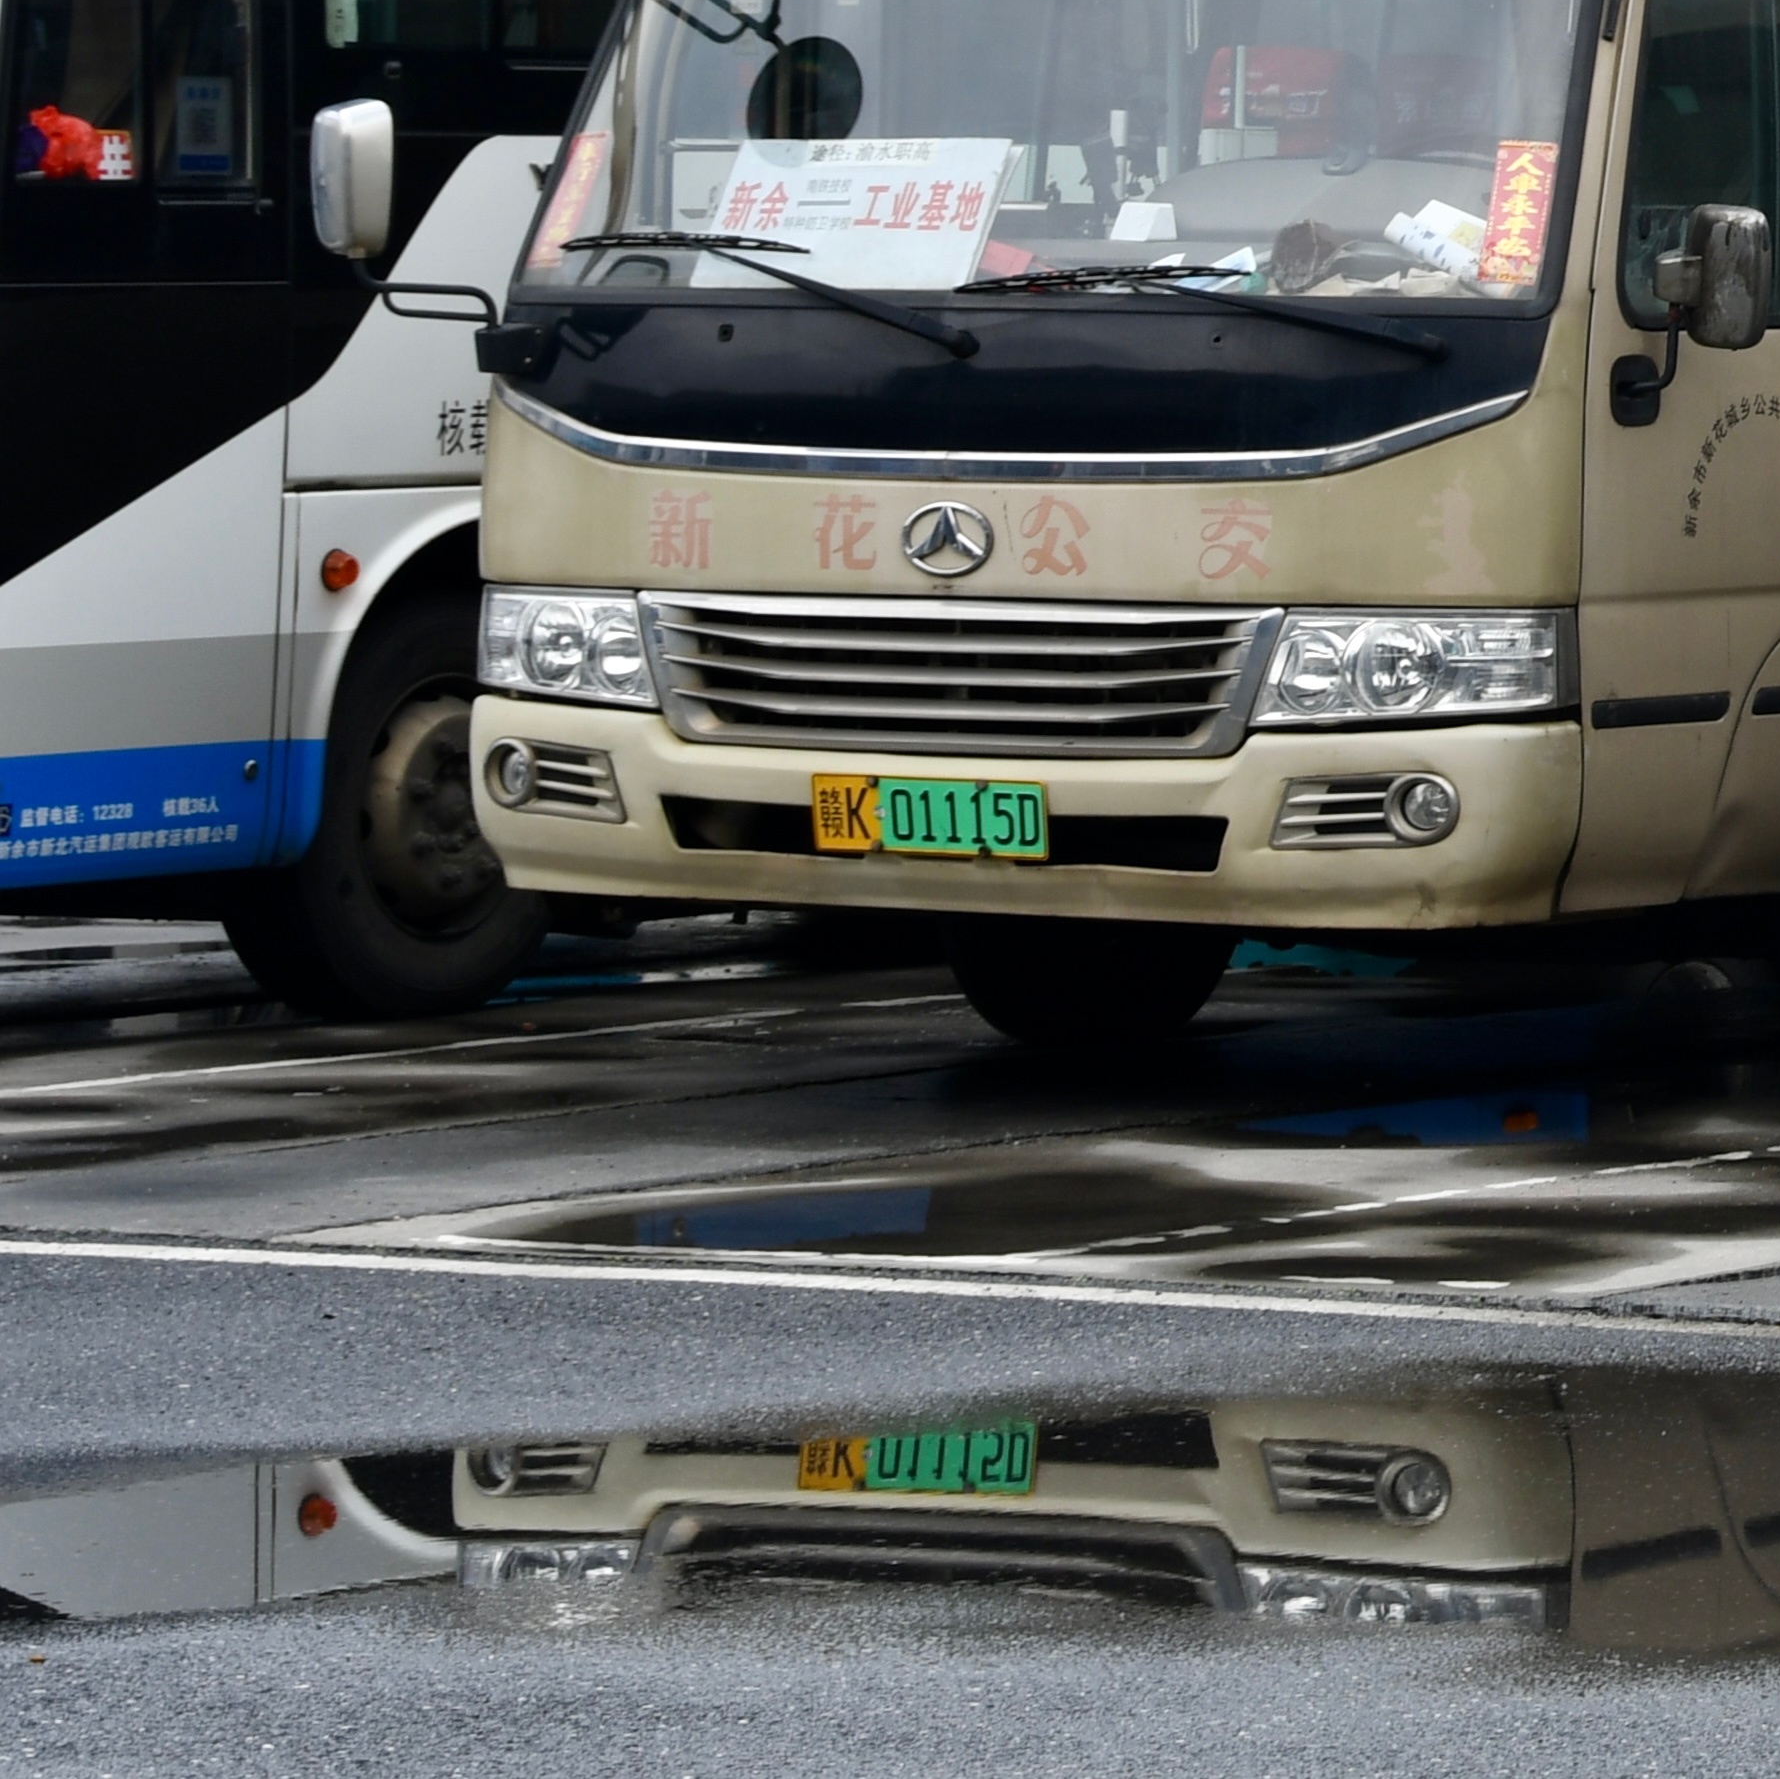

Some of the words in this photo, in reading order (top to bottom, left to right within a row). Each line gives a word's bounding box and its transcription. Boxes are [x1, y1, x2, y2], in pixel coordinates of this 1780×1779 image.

[721, 181, 790, 232] 新余
[853, 180, 987, 232] 工业基地
[93, 803, 133, 820] 12328
[819, 786, 871, 839] 赣K
[890, 789, 1040, 846] 01115D
